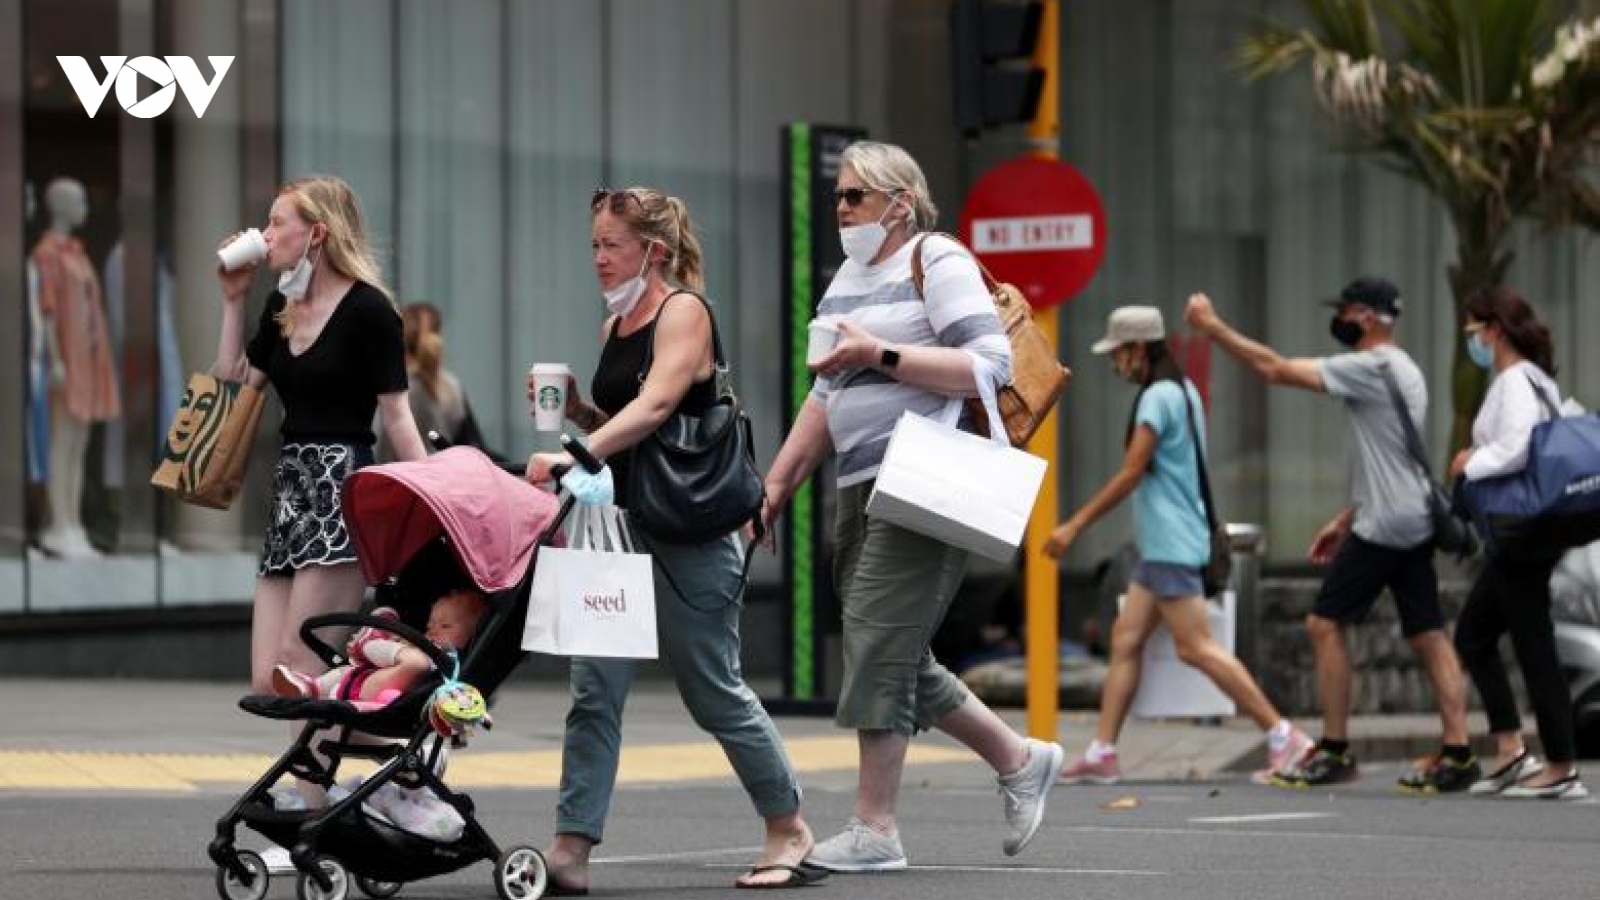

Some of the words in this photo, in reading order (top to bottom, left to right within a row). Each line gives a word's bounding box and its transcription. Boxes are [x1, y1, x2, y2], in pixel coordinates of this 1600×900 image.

[988, 223, 1011, 245] NO
[1022, 221, 1075, 244] ENTRY
[583, 588, 627, 613] seed
